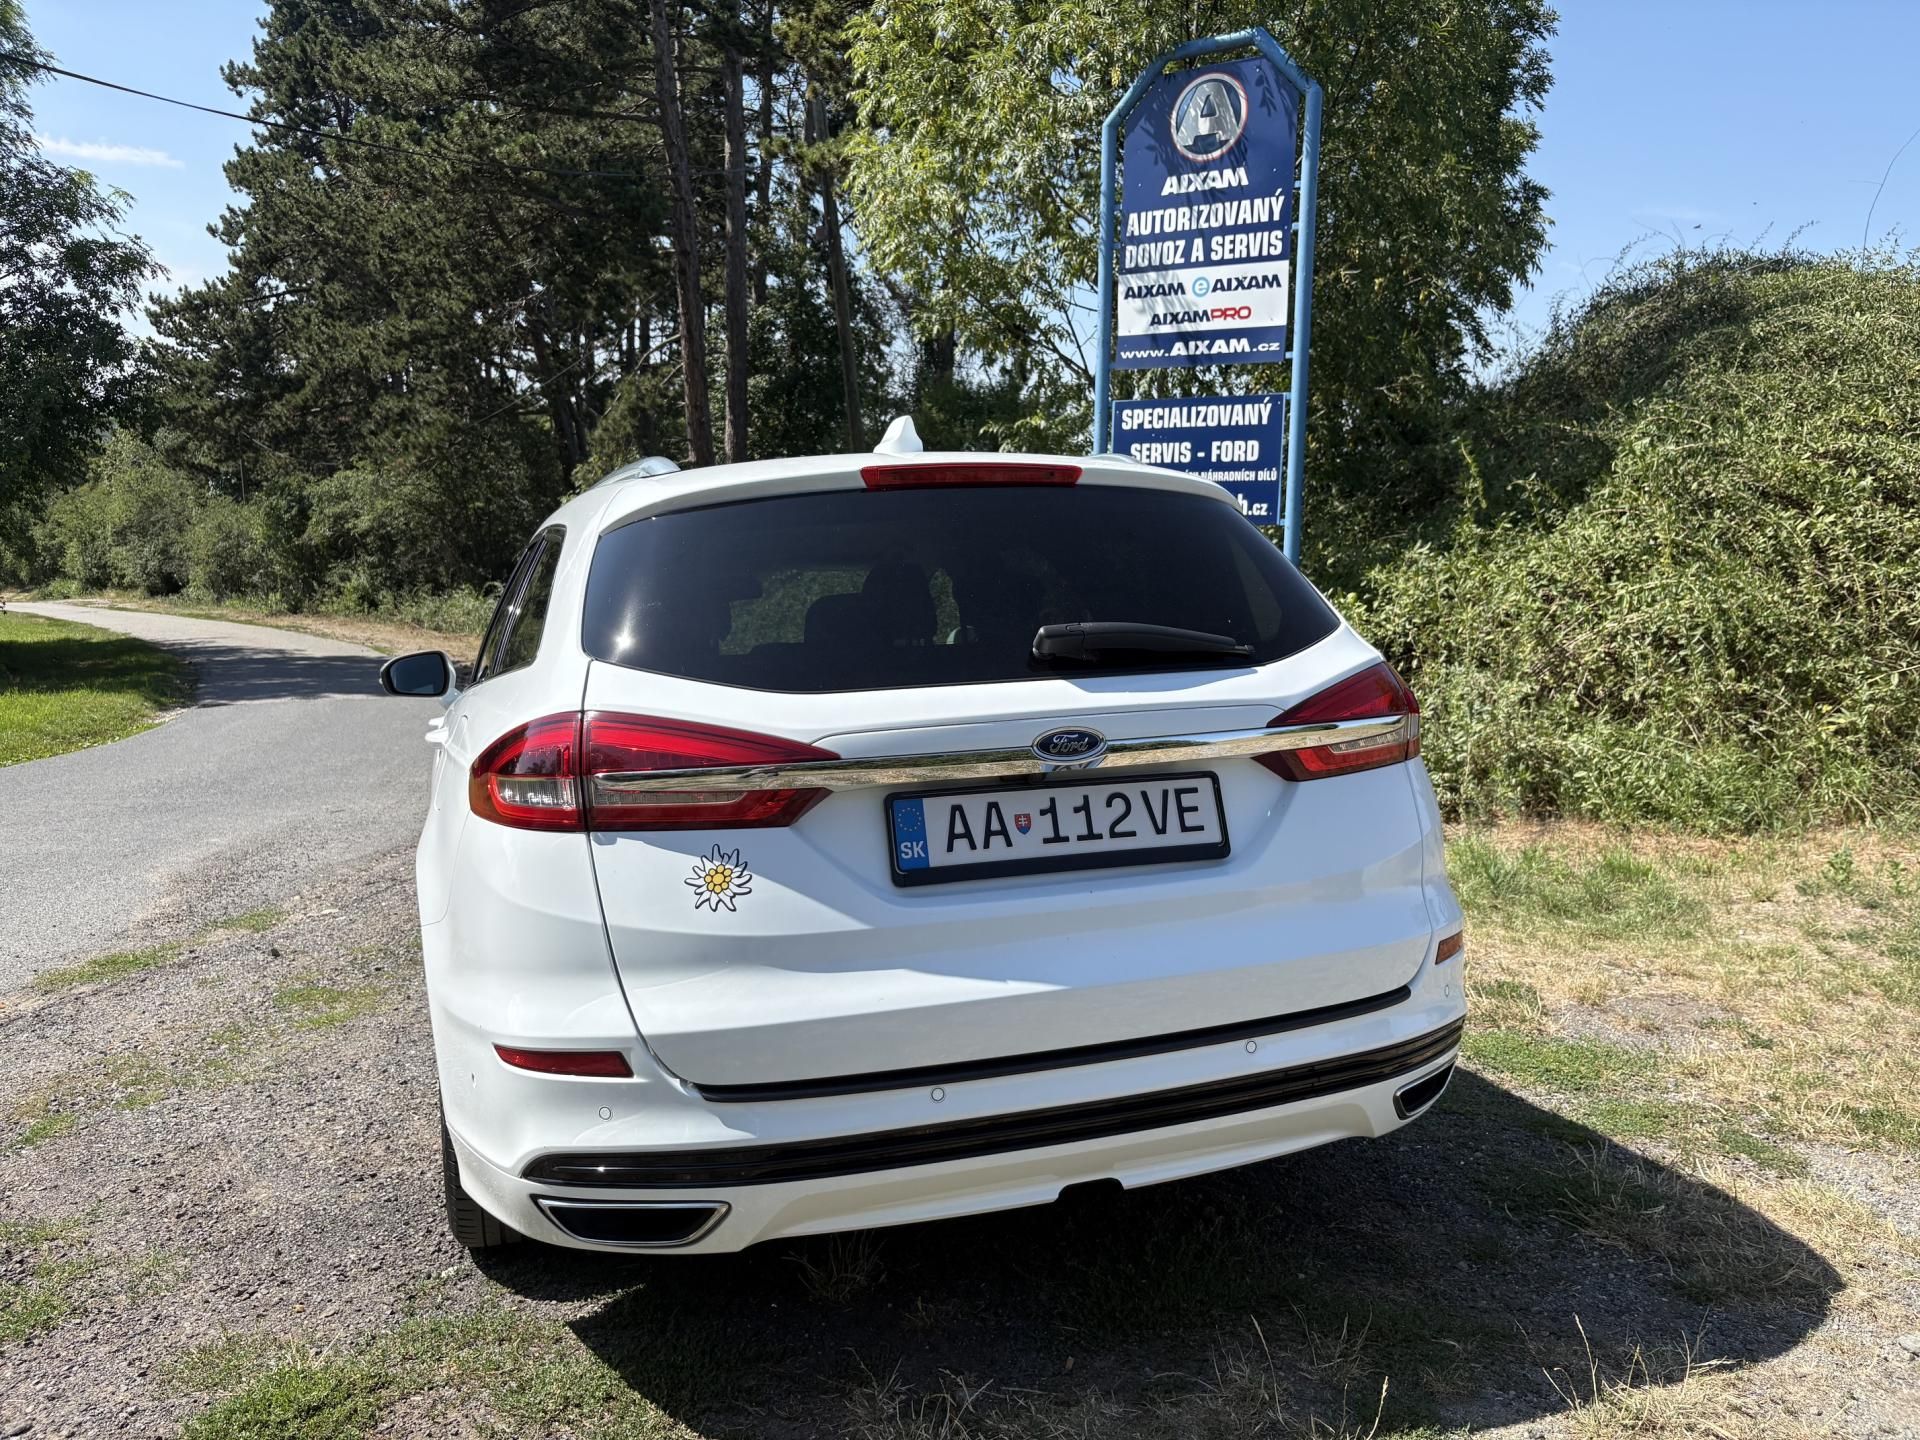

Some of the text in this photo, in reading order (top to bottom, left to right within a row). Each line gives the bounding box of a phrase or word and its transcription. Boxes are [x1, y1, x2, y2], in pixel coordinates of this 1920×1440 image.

[1176, 80, 1241, 147] A
[1161, 167, 1249, 197] AIXAM
[1126, 188, 1285, 237] AUTORIZOVANÝ
[1125, 230, 1283, 269] DOVOZ A SERVIS
[1124, 282, 1186, 300] AIXAM
[1149, 305, 1252, 327] AIXAMPRO
[1120, 337, 1281, 359] www.AIXAM.cz
[1121, 396, 1272, 430] SPECIALIZOVANÝ
[1130, 441, 1192, 464] SERVIS
[1211, 440, 1260, 463] FORD
[1201, 468, 1256, 482] NÁHRADNÍCH
[1237, 493, 1268, 516] h.cz
[1050, 734, 1090, 754] Ford
[946, 786, 1205, 853] AA 112VE
[900, 840, 927, 860] SK
